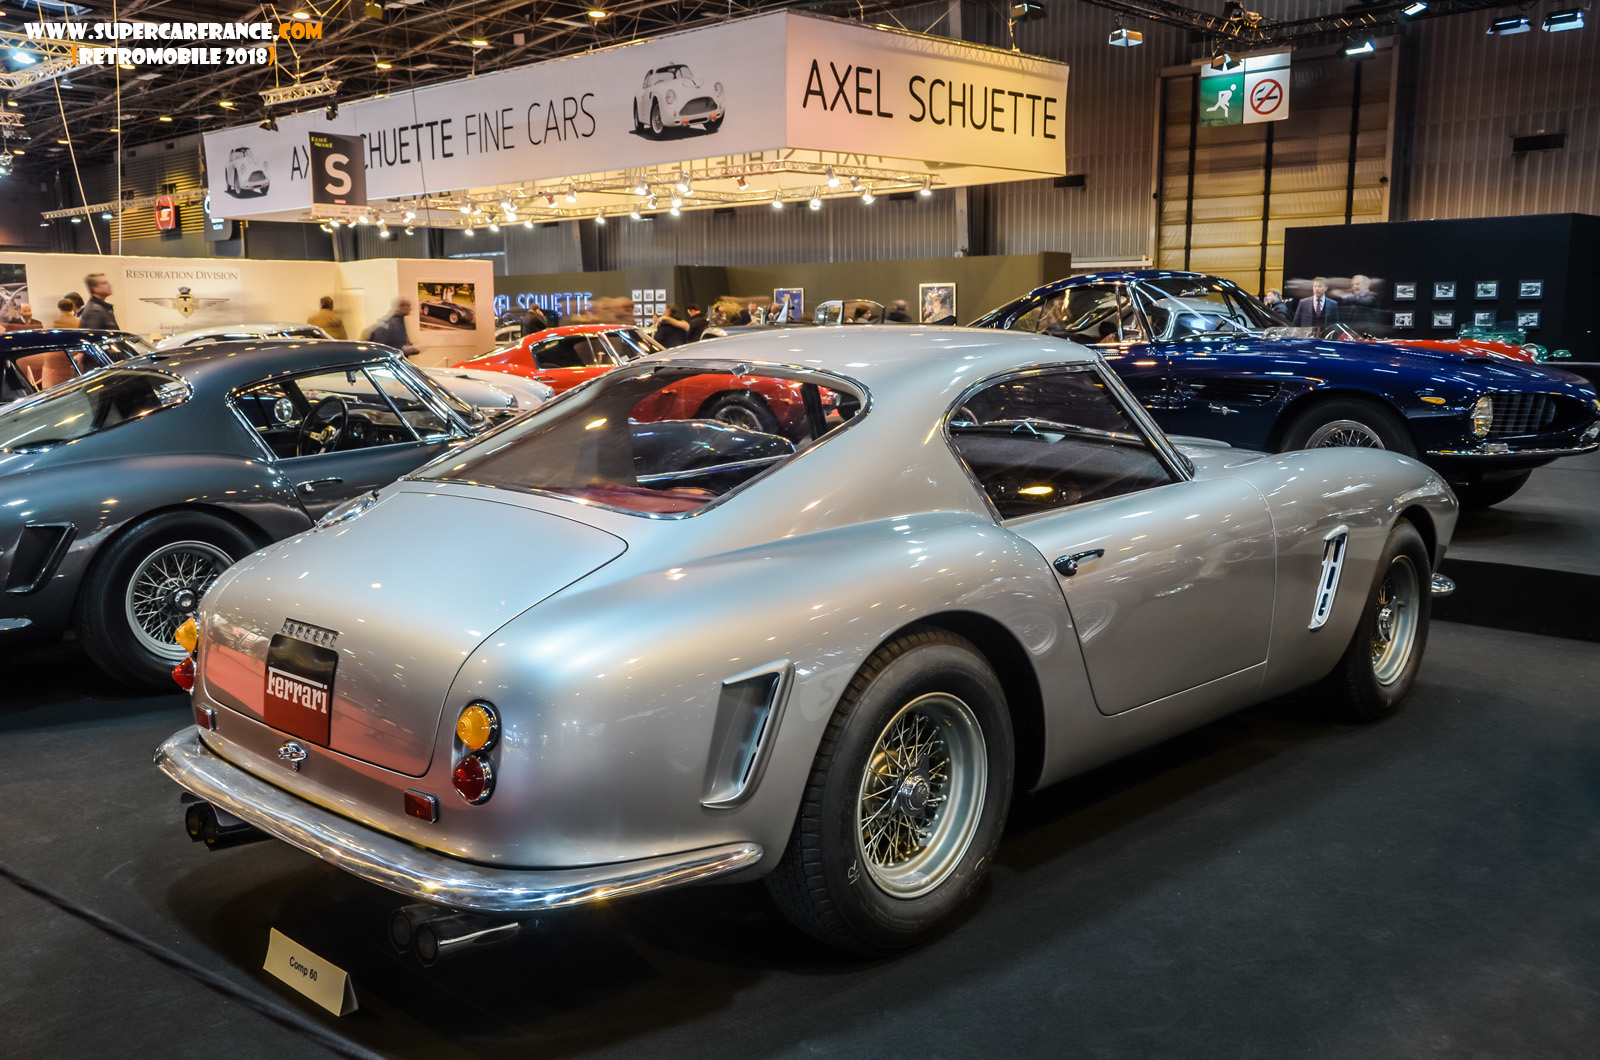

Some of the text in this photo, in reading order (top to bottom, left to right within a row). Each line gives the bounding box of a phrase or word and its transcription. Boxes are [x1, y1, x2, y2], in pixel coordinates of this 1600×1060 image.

[802, 58, 1057, 140] AXEL SCHUETTE
[465, 107, 515, 155] FINE
[527, 92, 596, 146] CARS
[324, 152, 352, 196] S
[125, 269, 238, 281] RESTORATION DIVISION
[266, 666, 328, 715] Ferrari
[289, 956, 318, 982] Comp 60
